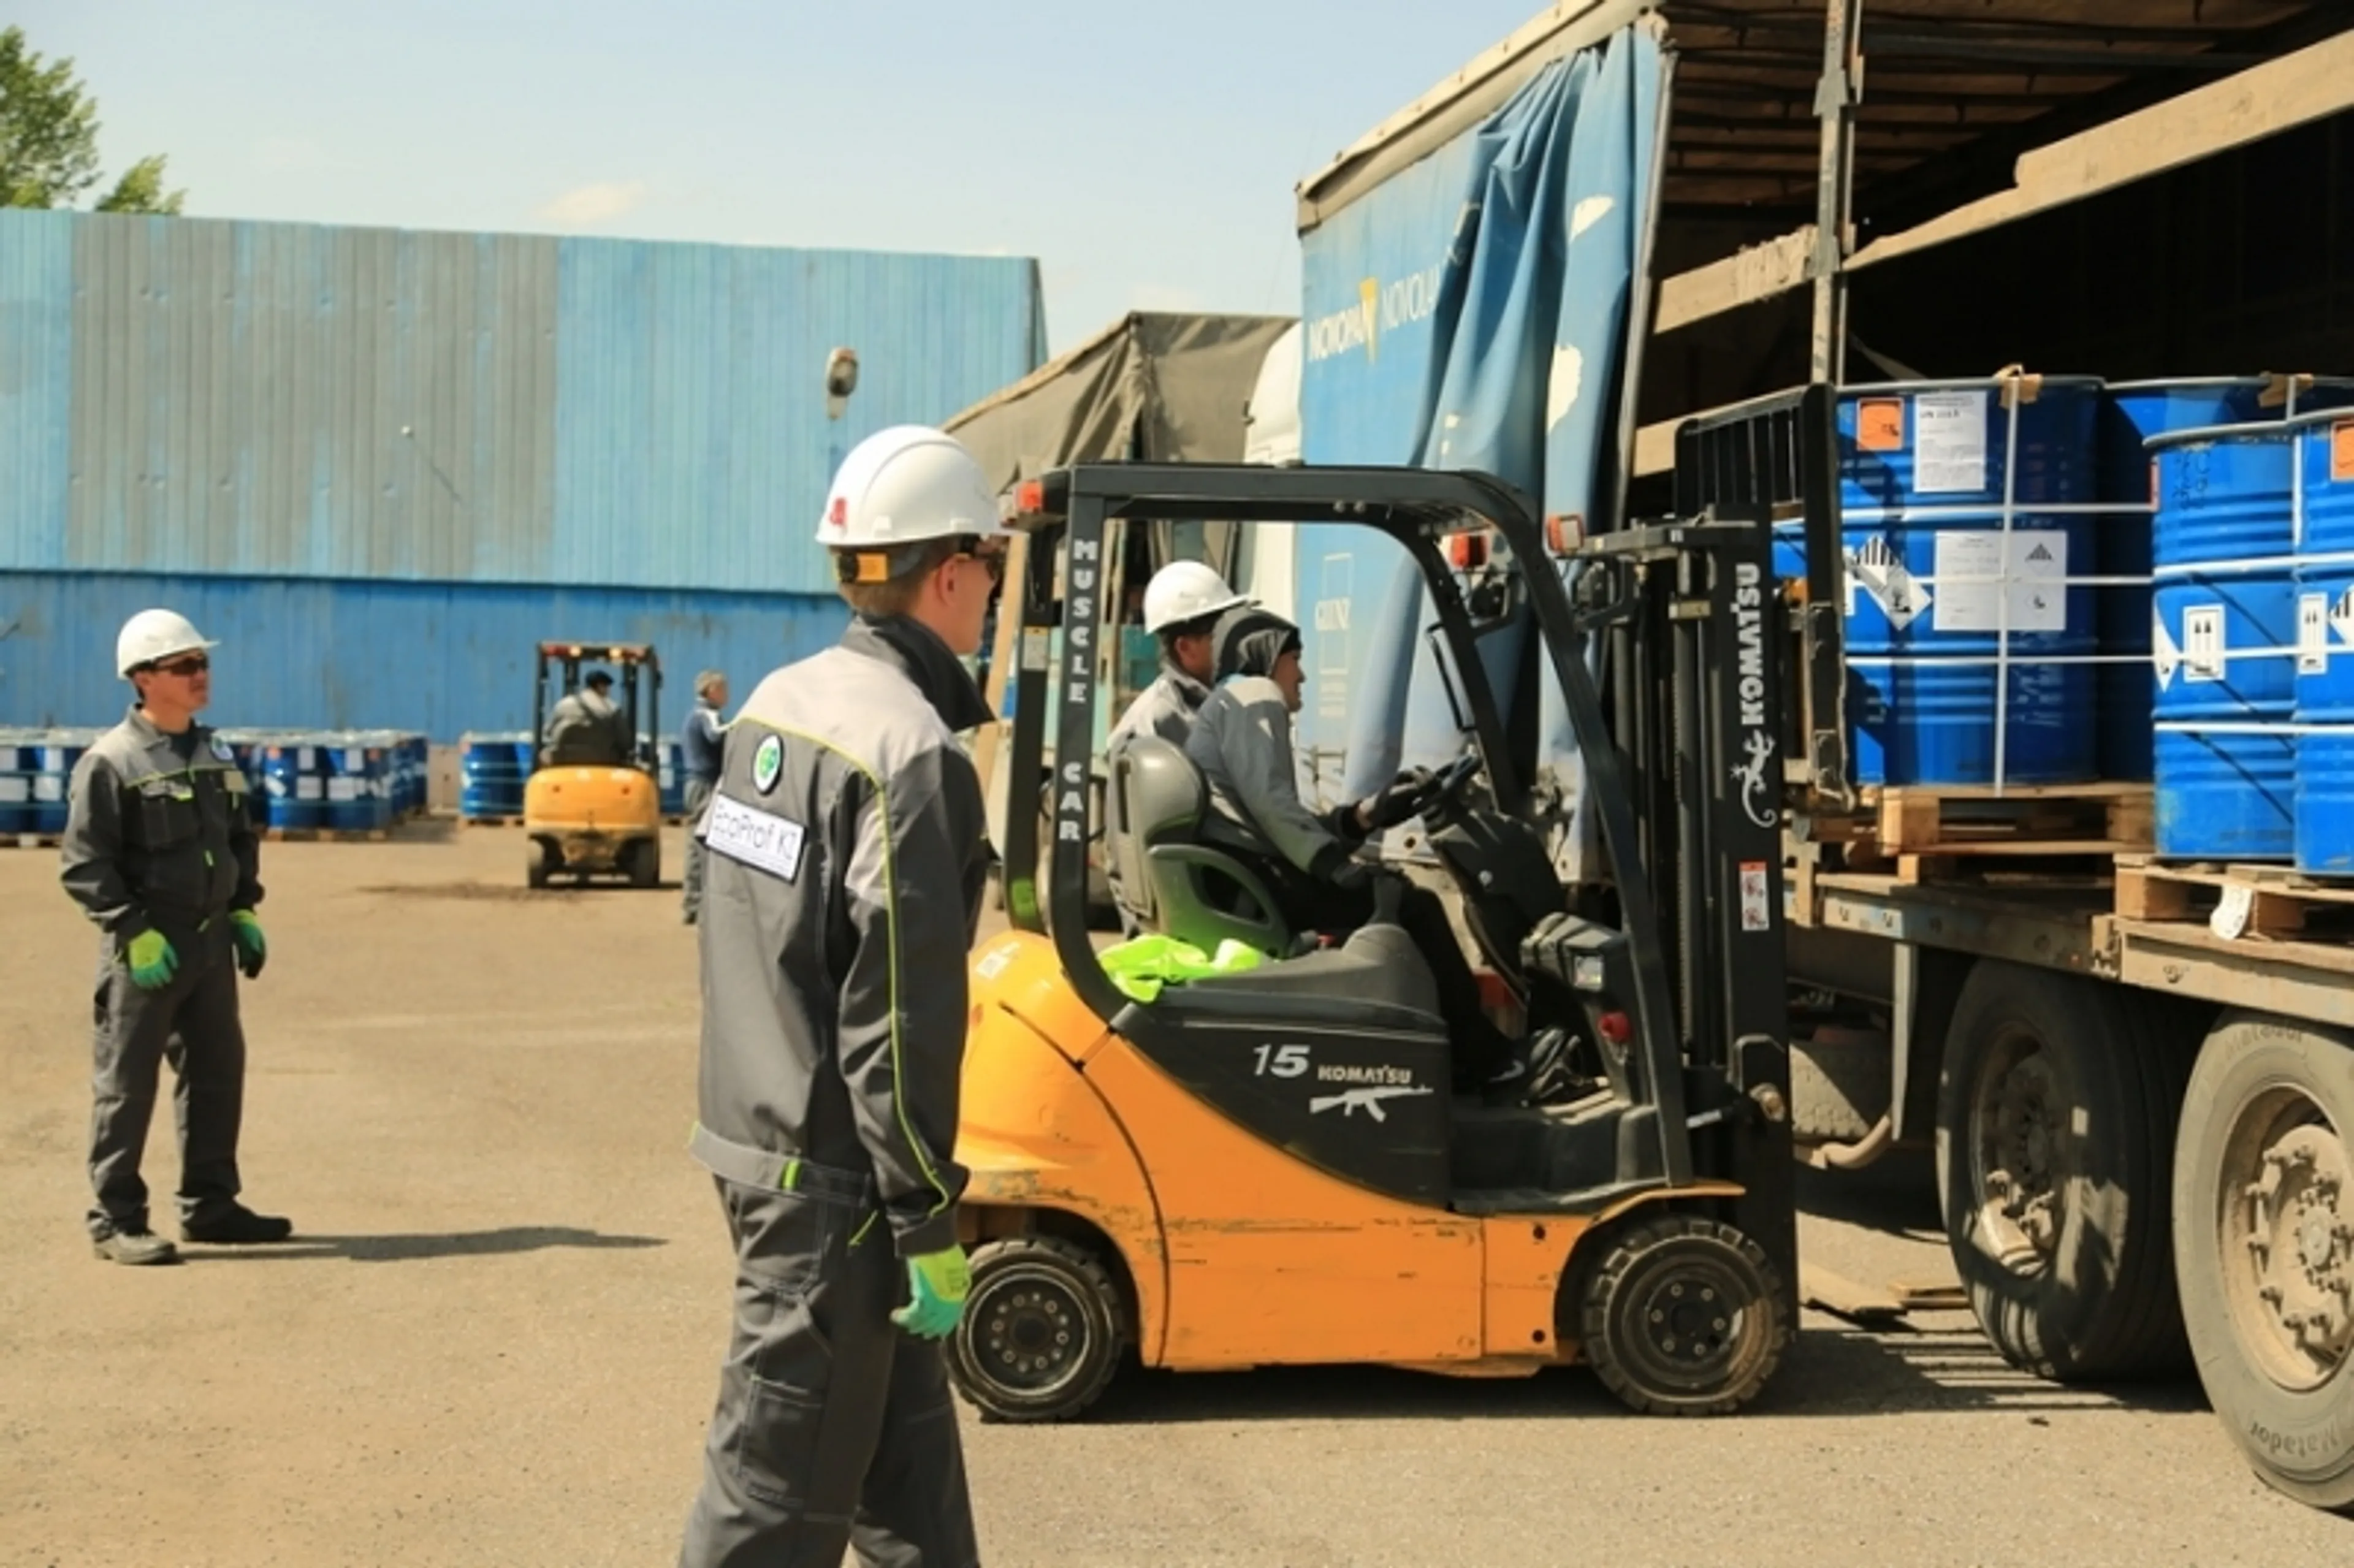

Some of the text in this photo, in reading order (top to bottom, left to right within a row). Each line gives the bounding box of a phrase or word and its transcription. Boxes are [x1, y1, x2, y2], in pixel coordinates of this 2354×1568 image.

[1059, 540, 1098, 840] MUSCLE CAR
[1731, 563, 1764, 725] KOMATSU
[1253, 1045, 1311, 1078] 15
[1317, 1065, 1412, 1084] KOMATSU
